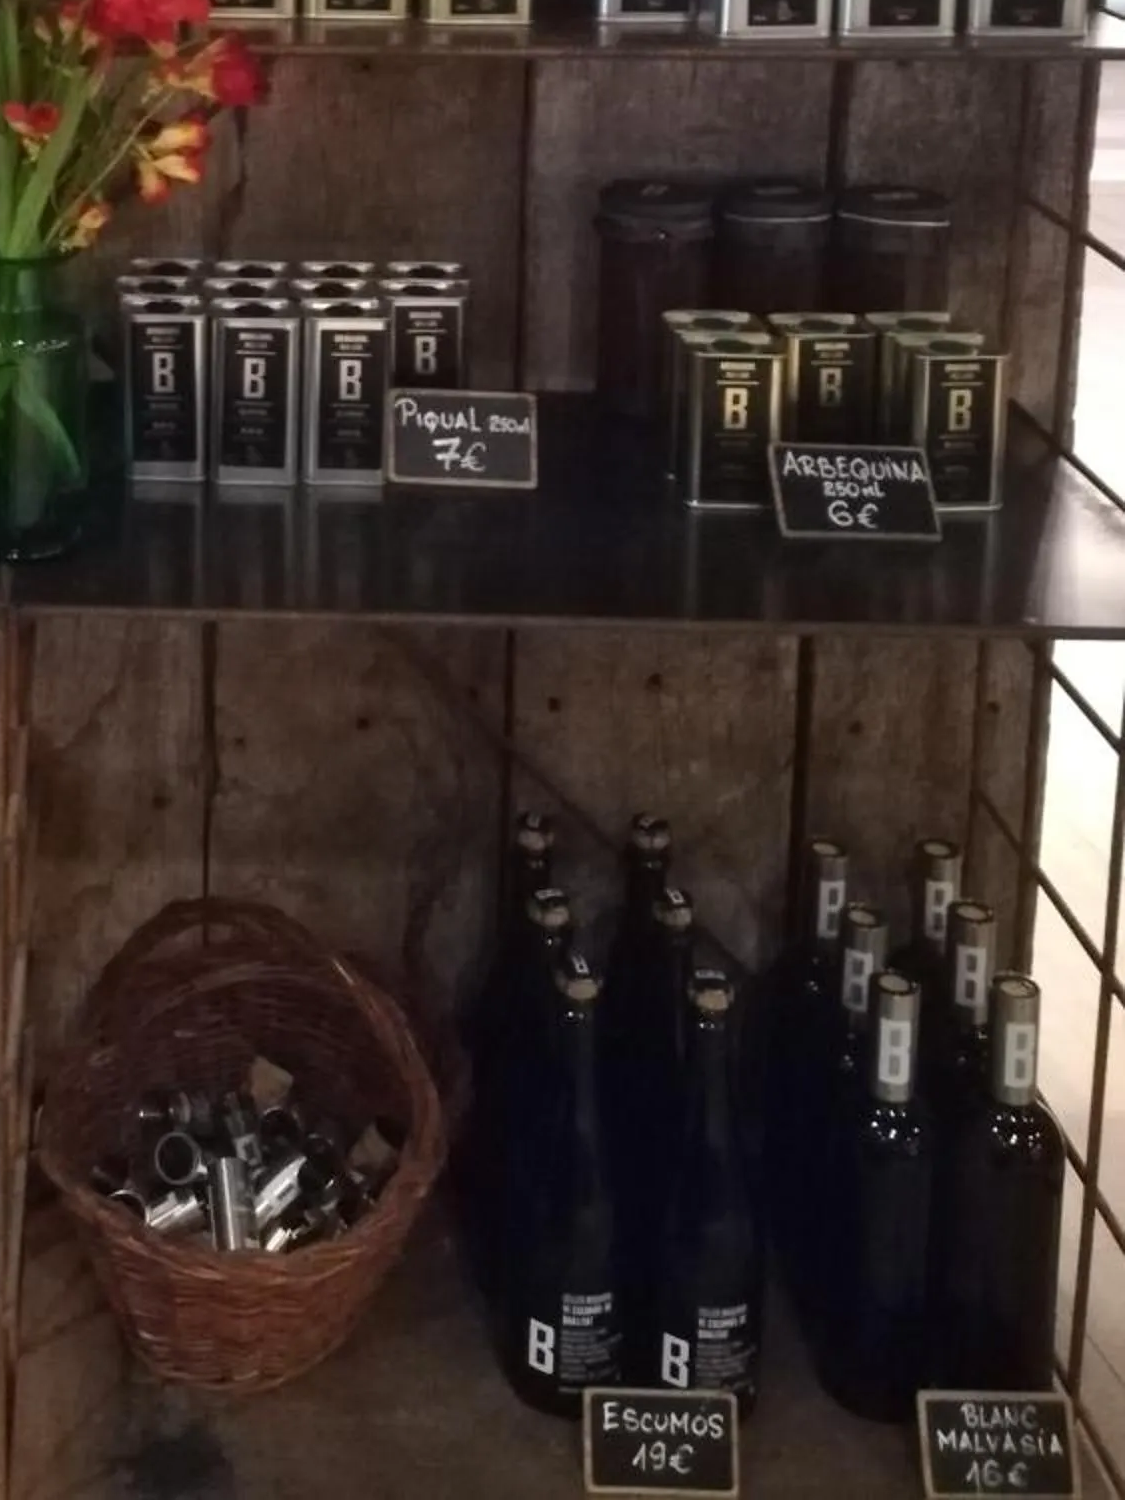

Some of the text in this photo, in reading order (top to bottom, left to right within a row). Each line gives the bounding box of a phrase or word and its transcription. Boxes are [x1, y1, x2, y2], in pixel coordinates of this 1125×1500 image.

[153, 353, 175, 393] B
[415, 336, 437, 374] B
[244, 358, 266, 398] B
[339, 360, 362, 400] B
[820, 368, 842, 406] B
[395, 398, 481, 433] PIQUAL
[724, 388, 748, 429] B
[949, 389, 972, 431] B
[432, 437, 486, 472] 7€
[827, 500, 879, 528] 6€
[842, 948, 874, 1012] B
[955, 945, 987, 1006] B
[878, 1018, 911, 1085] B
[1004, 1023, 1035, 1087] B
[528, 1317, 555, 1375] B
[662, 1332, 690, 1388] B
[961, 1403, 1038, 1429] BLANC
[632, 1441, 694, 1474] 19€
[966, 1459, 1028, 1492] 16€
